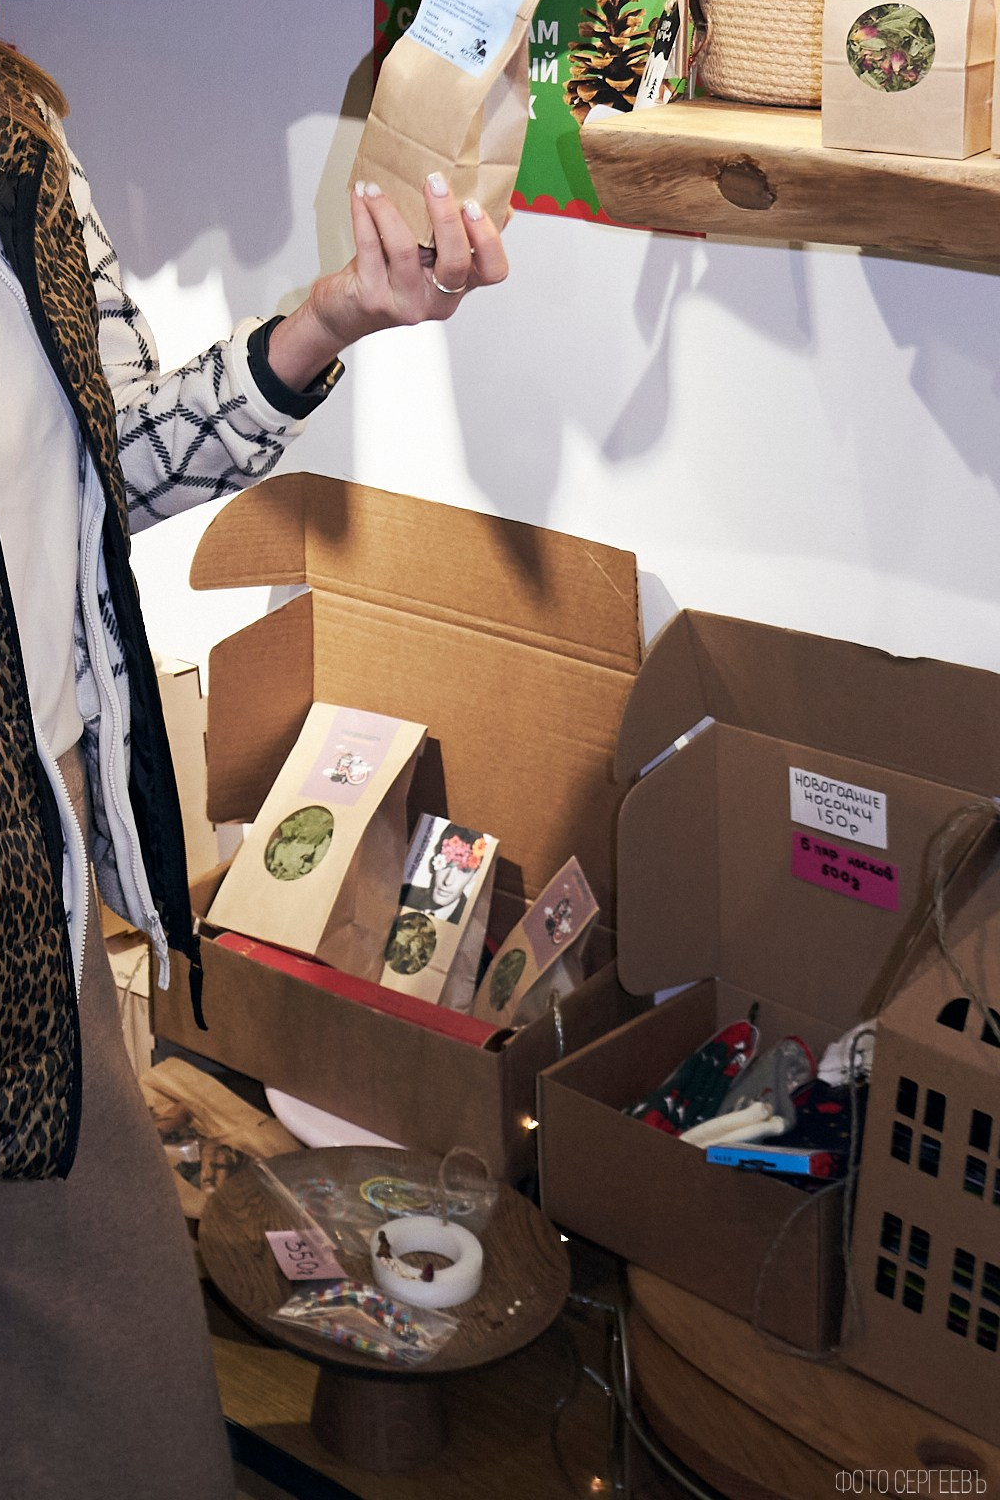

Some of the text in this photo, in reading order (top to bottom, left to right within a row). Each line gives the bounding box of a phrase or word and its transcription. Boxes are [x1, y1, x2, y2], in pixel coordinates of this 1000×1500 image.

[460, 47, 485, 65] КУТЯТА
[795, 772, 881, 810] НОВОГОДНИЕ
[803, 789, 873, 823] НОСОЧКИ
